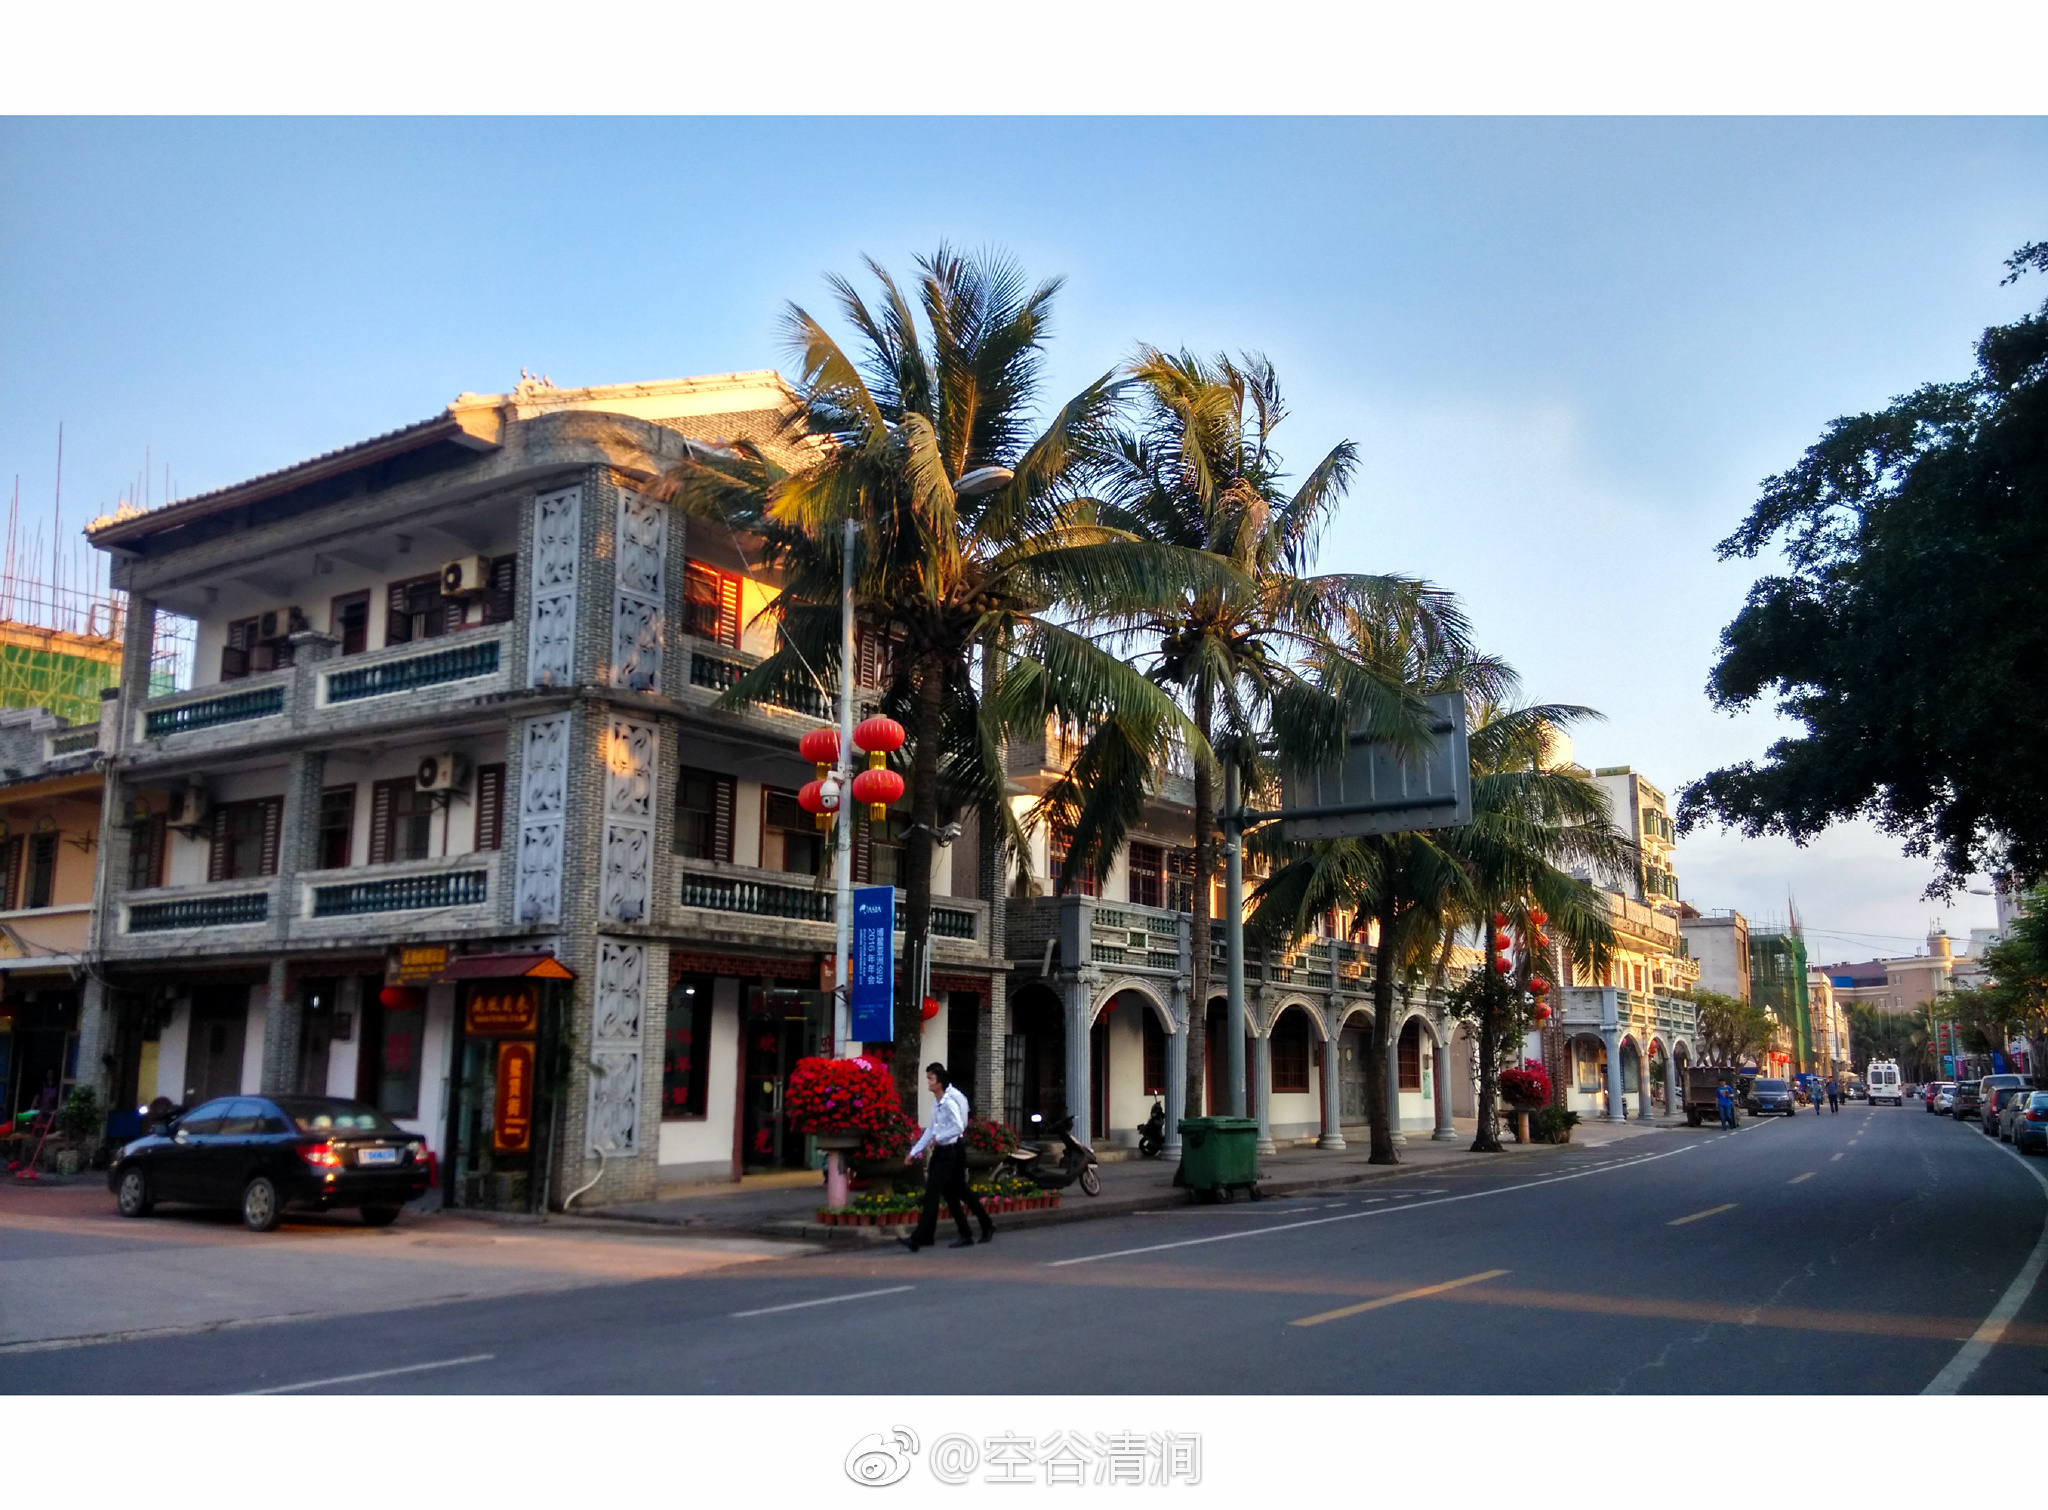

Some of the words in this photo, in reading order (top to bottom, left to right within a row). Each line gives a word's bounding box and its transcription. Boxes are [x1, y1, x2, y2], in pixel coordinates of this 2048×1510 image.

[868, 928, 876, 952] 2016
[867, 954, 876, 985] 年年会
